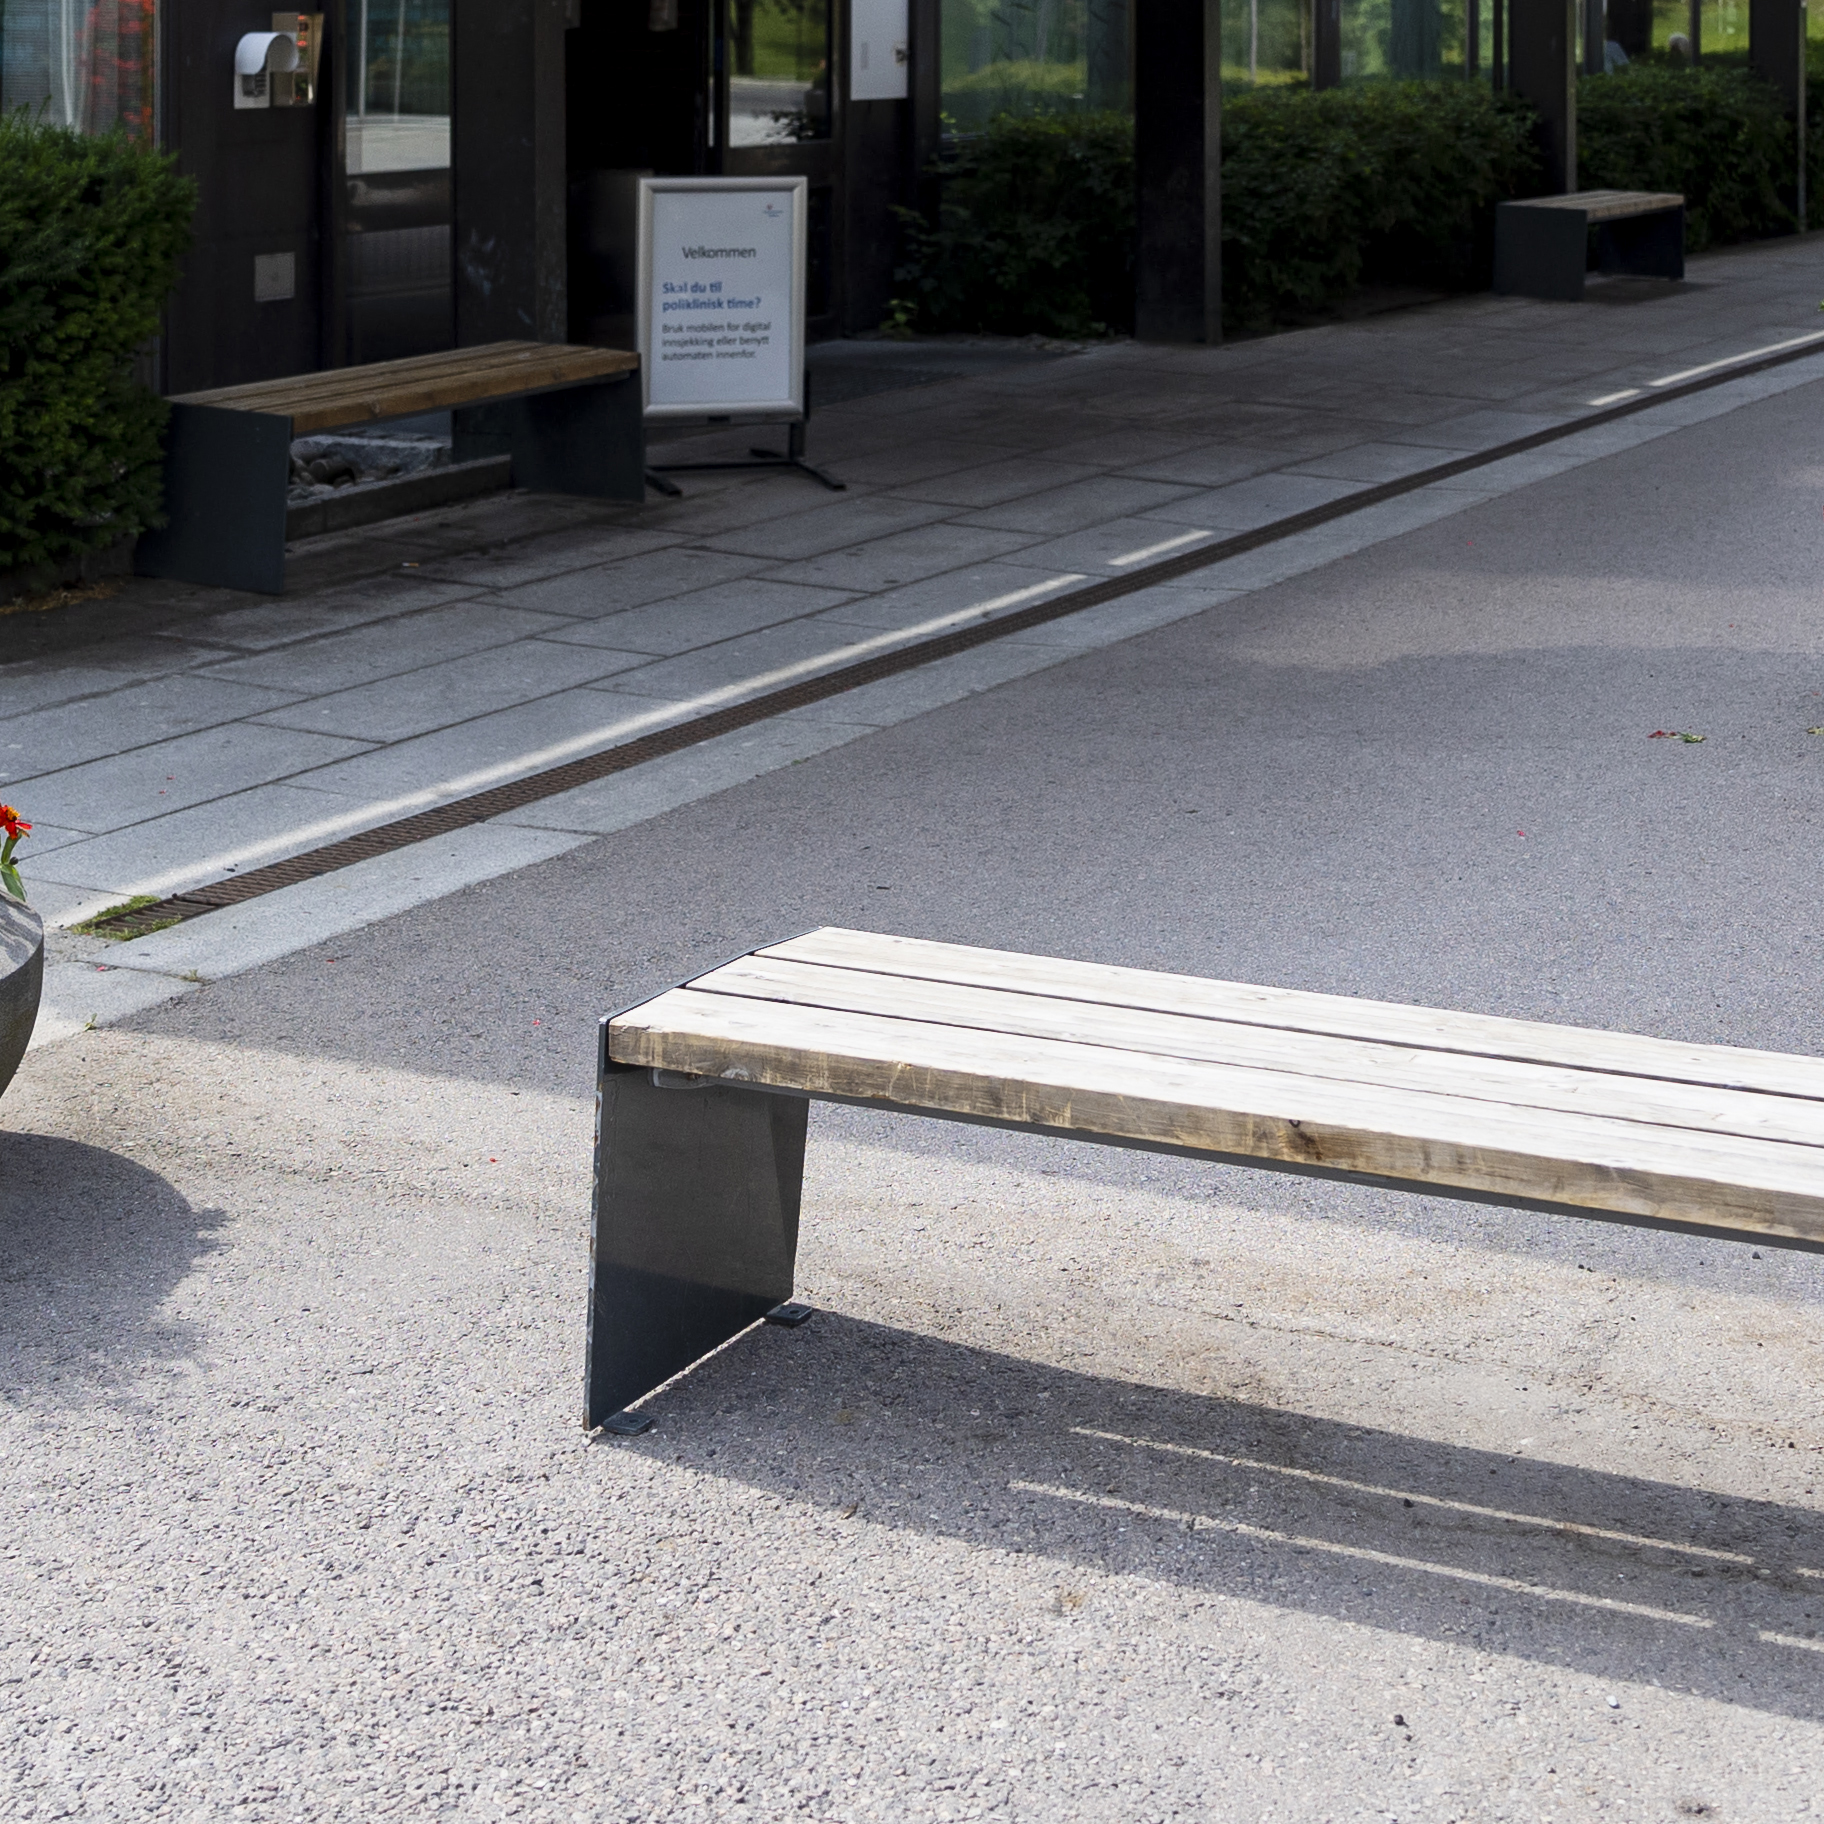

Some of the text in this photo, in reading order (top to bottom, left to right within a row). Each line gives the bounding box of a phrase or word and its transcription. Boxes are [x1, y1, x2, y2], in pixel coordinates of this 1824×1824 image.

[682, 245, 756, 259] Velkommen
[662, 281, 723, 294] Skal du til
[662, 296, 762, 313] poliklinisk time?
[661, 321, 772, 334] Bruk mobilen for digital
